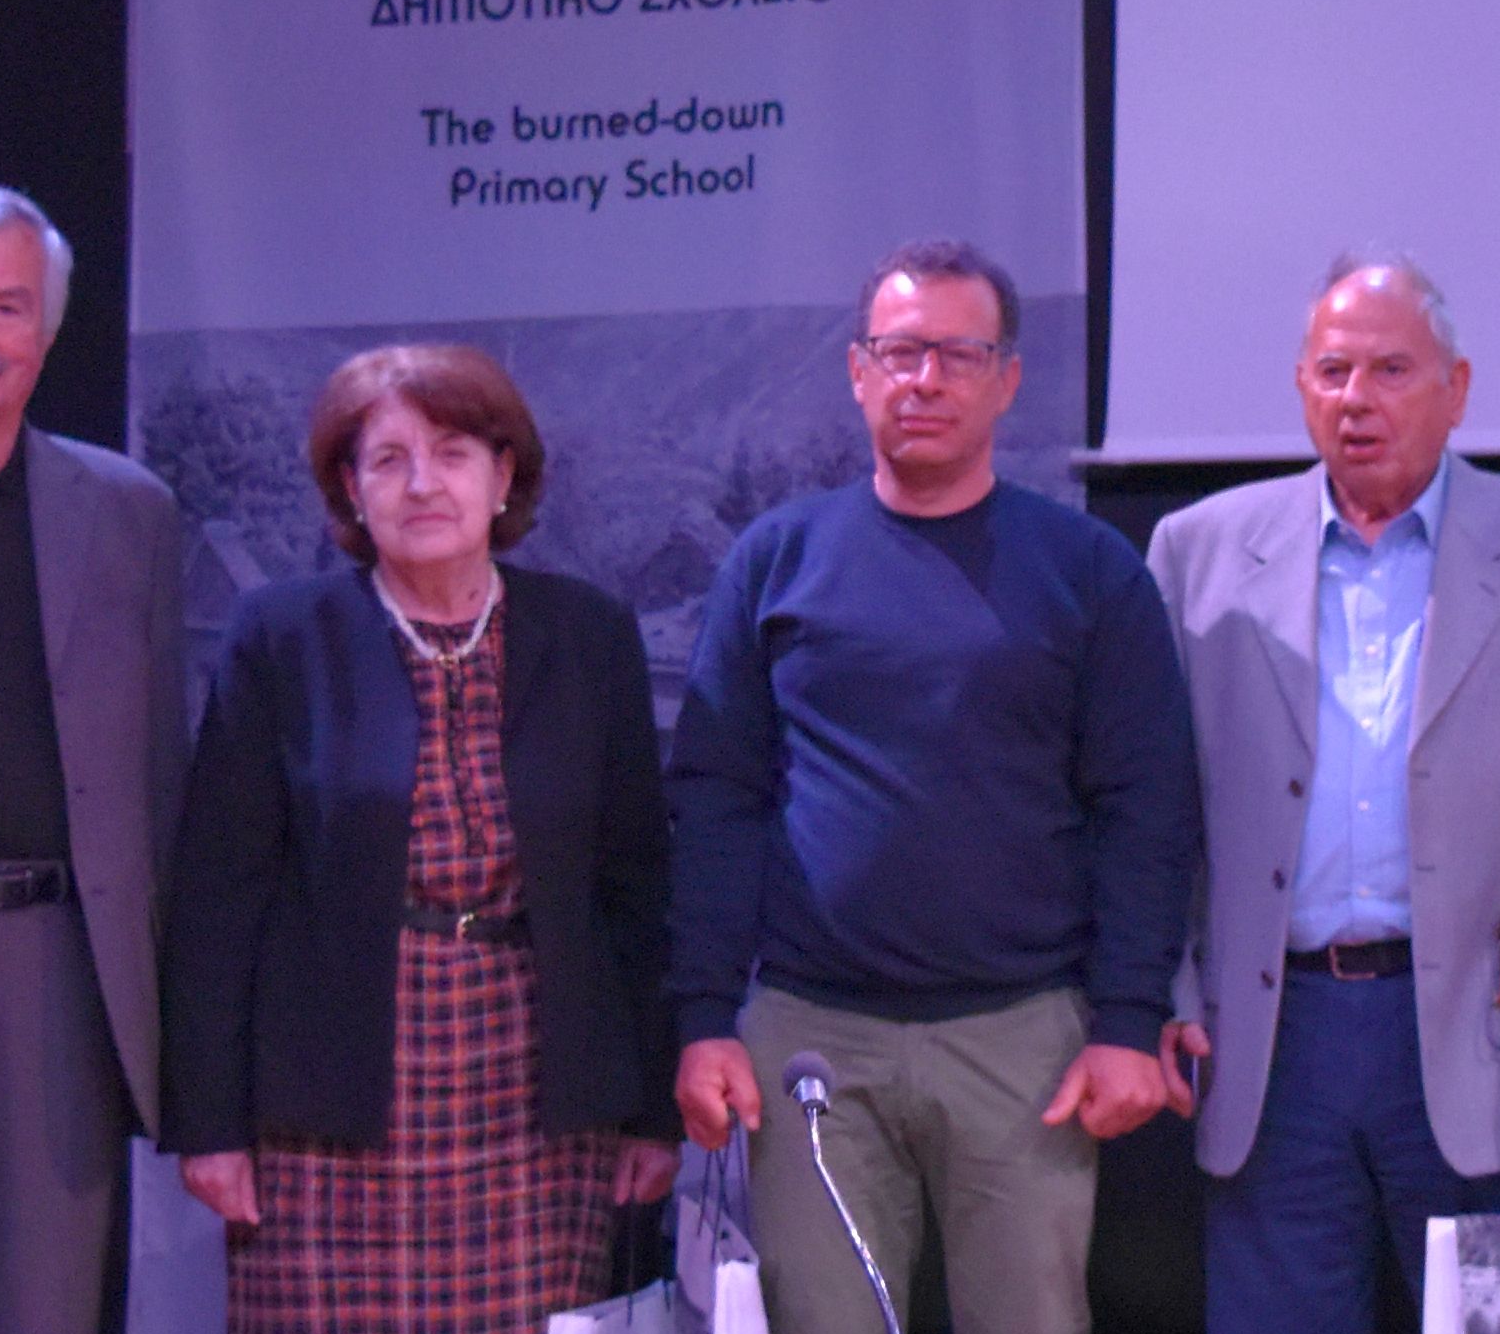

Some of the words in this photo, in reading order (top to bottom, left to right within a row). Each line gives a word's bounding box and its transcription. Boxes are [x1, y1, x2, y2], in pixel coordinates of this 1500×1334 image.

[420, 106, 496, 147] The
[512, 96, 785, 143] burned-down
[450, 165, 609, 211] Primary
[623, 153, 756, 200] School
